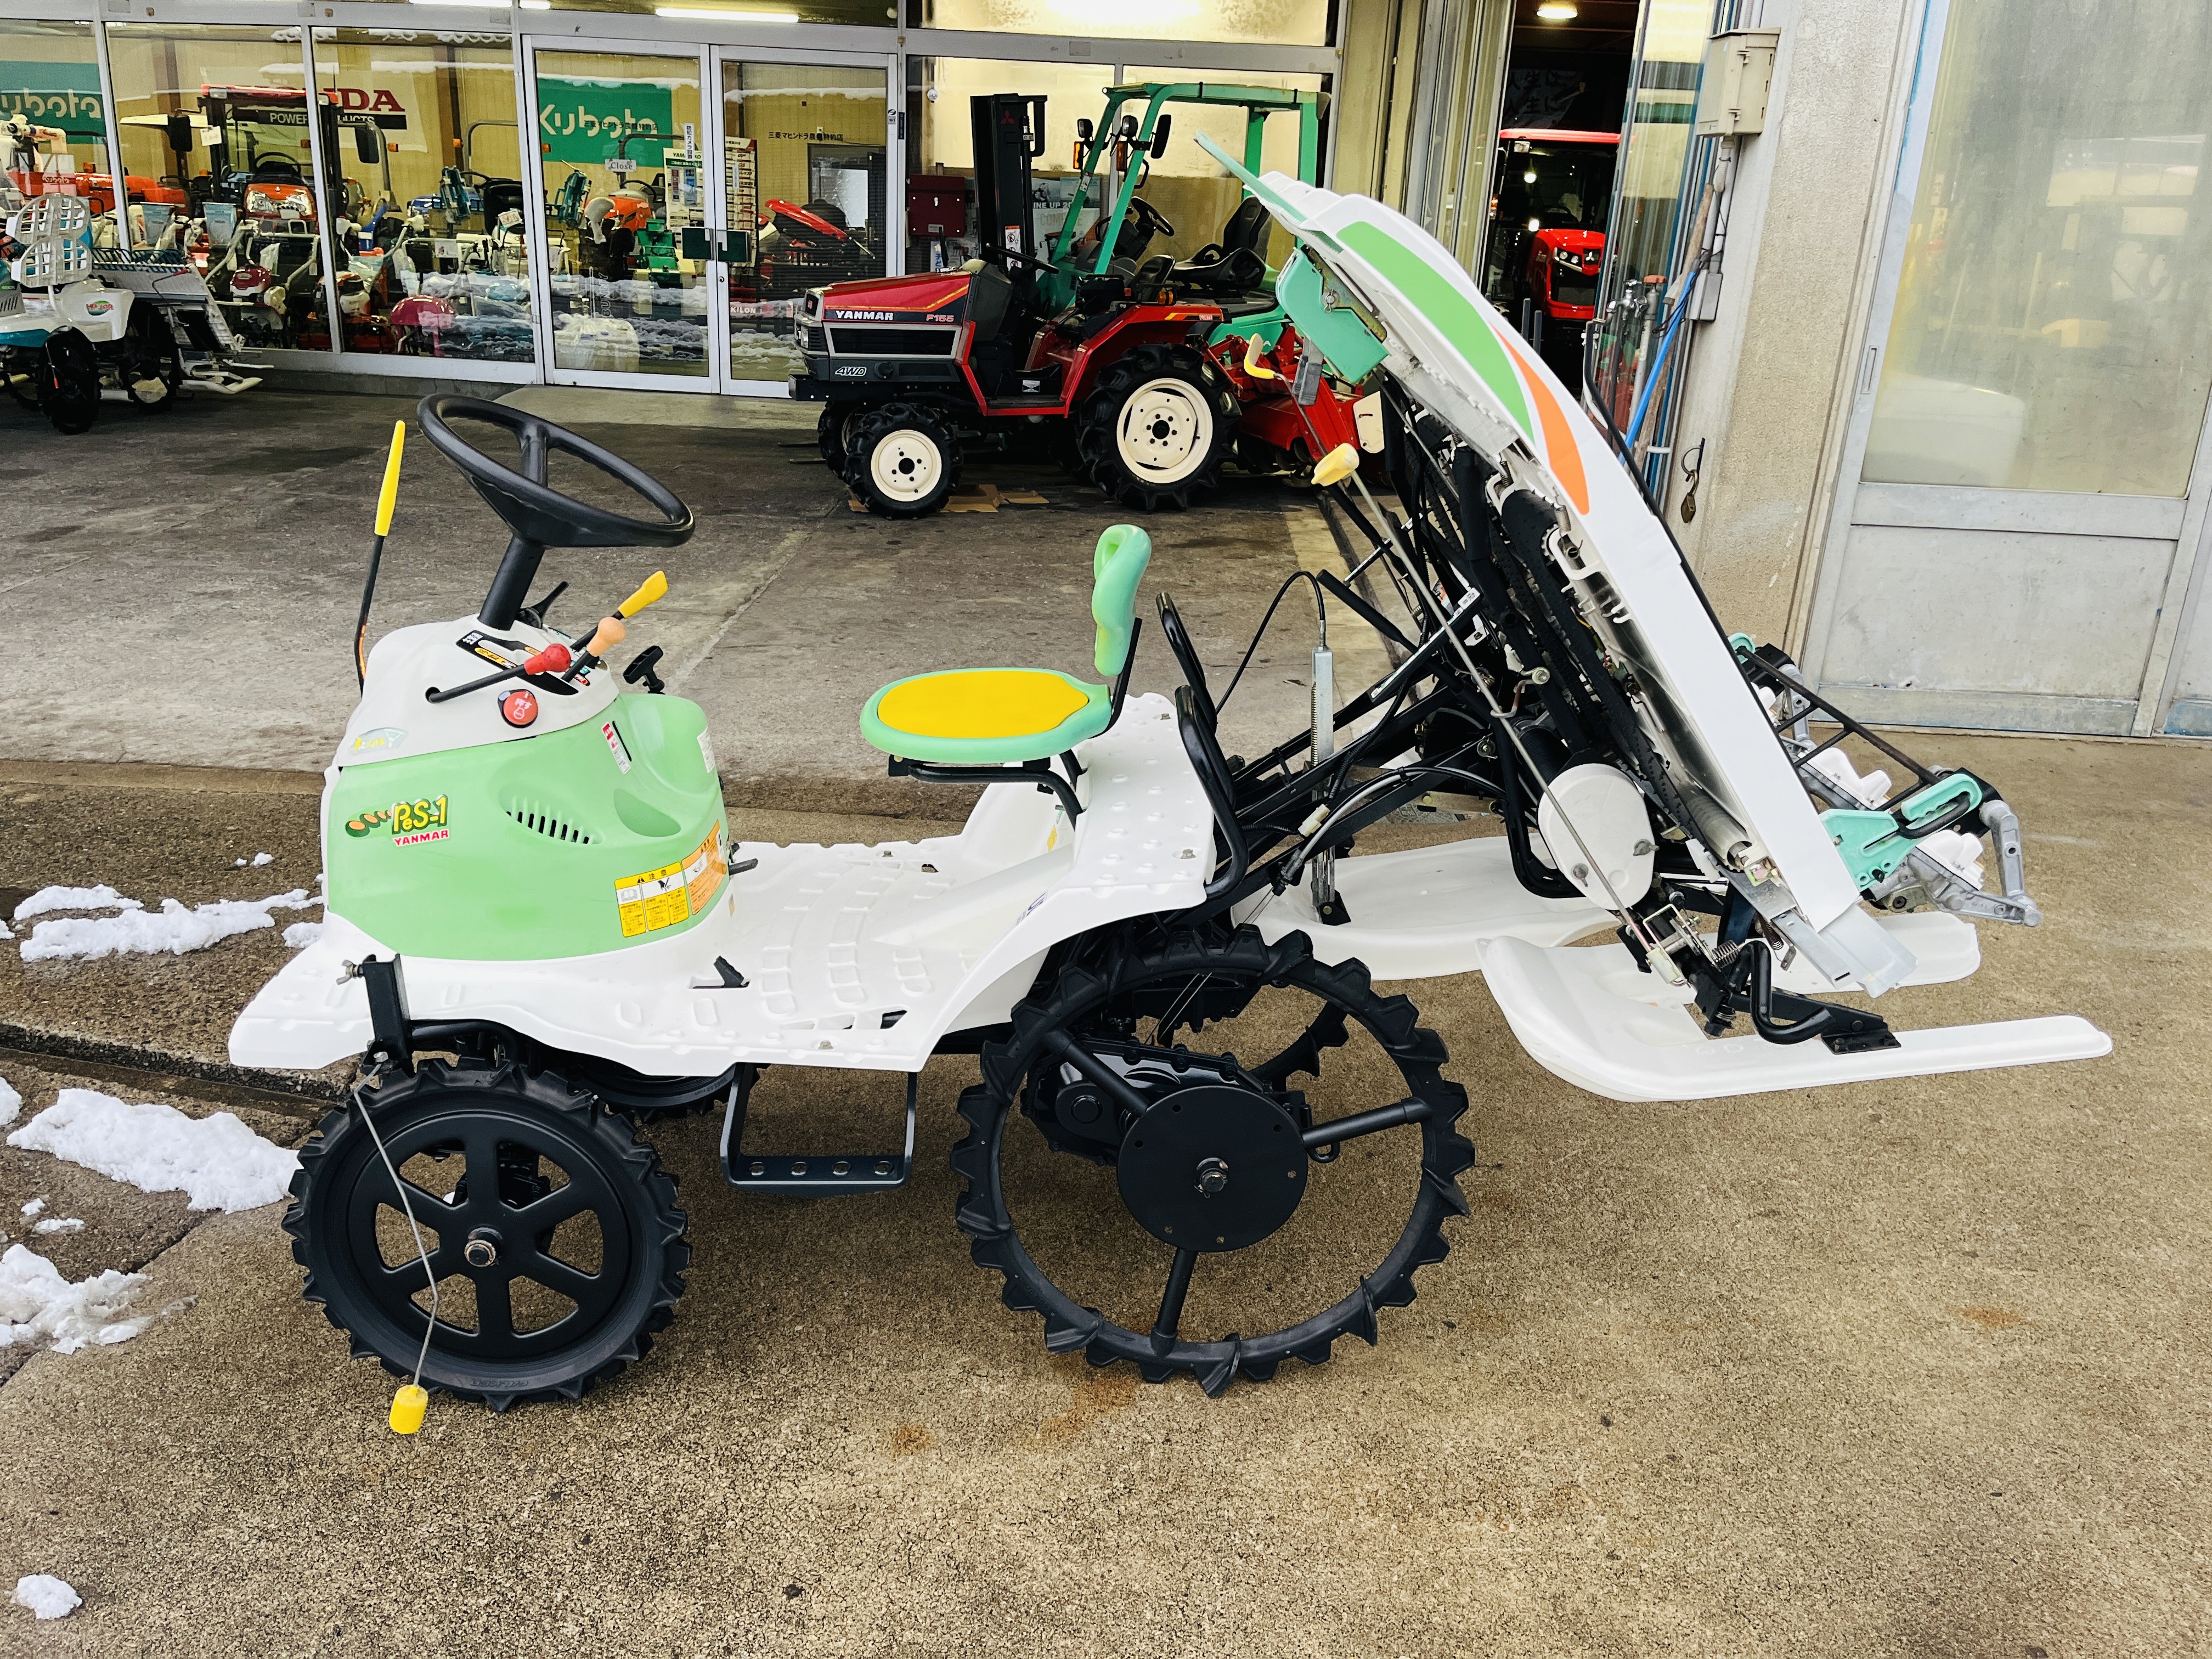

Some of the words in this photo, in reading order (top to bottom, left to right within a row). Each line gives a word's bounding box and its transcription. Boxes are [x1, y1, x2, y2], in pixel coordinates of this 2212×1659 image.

[1, 87, 101, 119] ubota
[540, 104, 658, 141] Kubota
[610, 162, 633, 170] Close
[836, 311, 894, 321] YANMAR
[835, 366, 867, 376] 4WD
[394, 830, 449, 845] YANMAR
